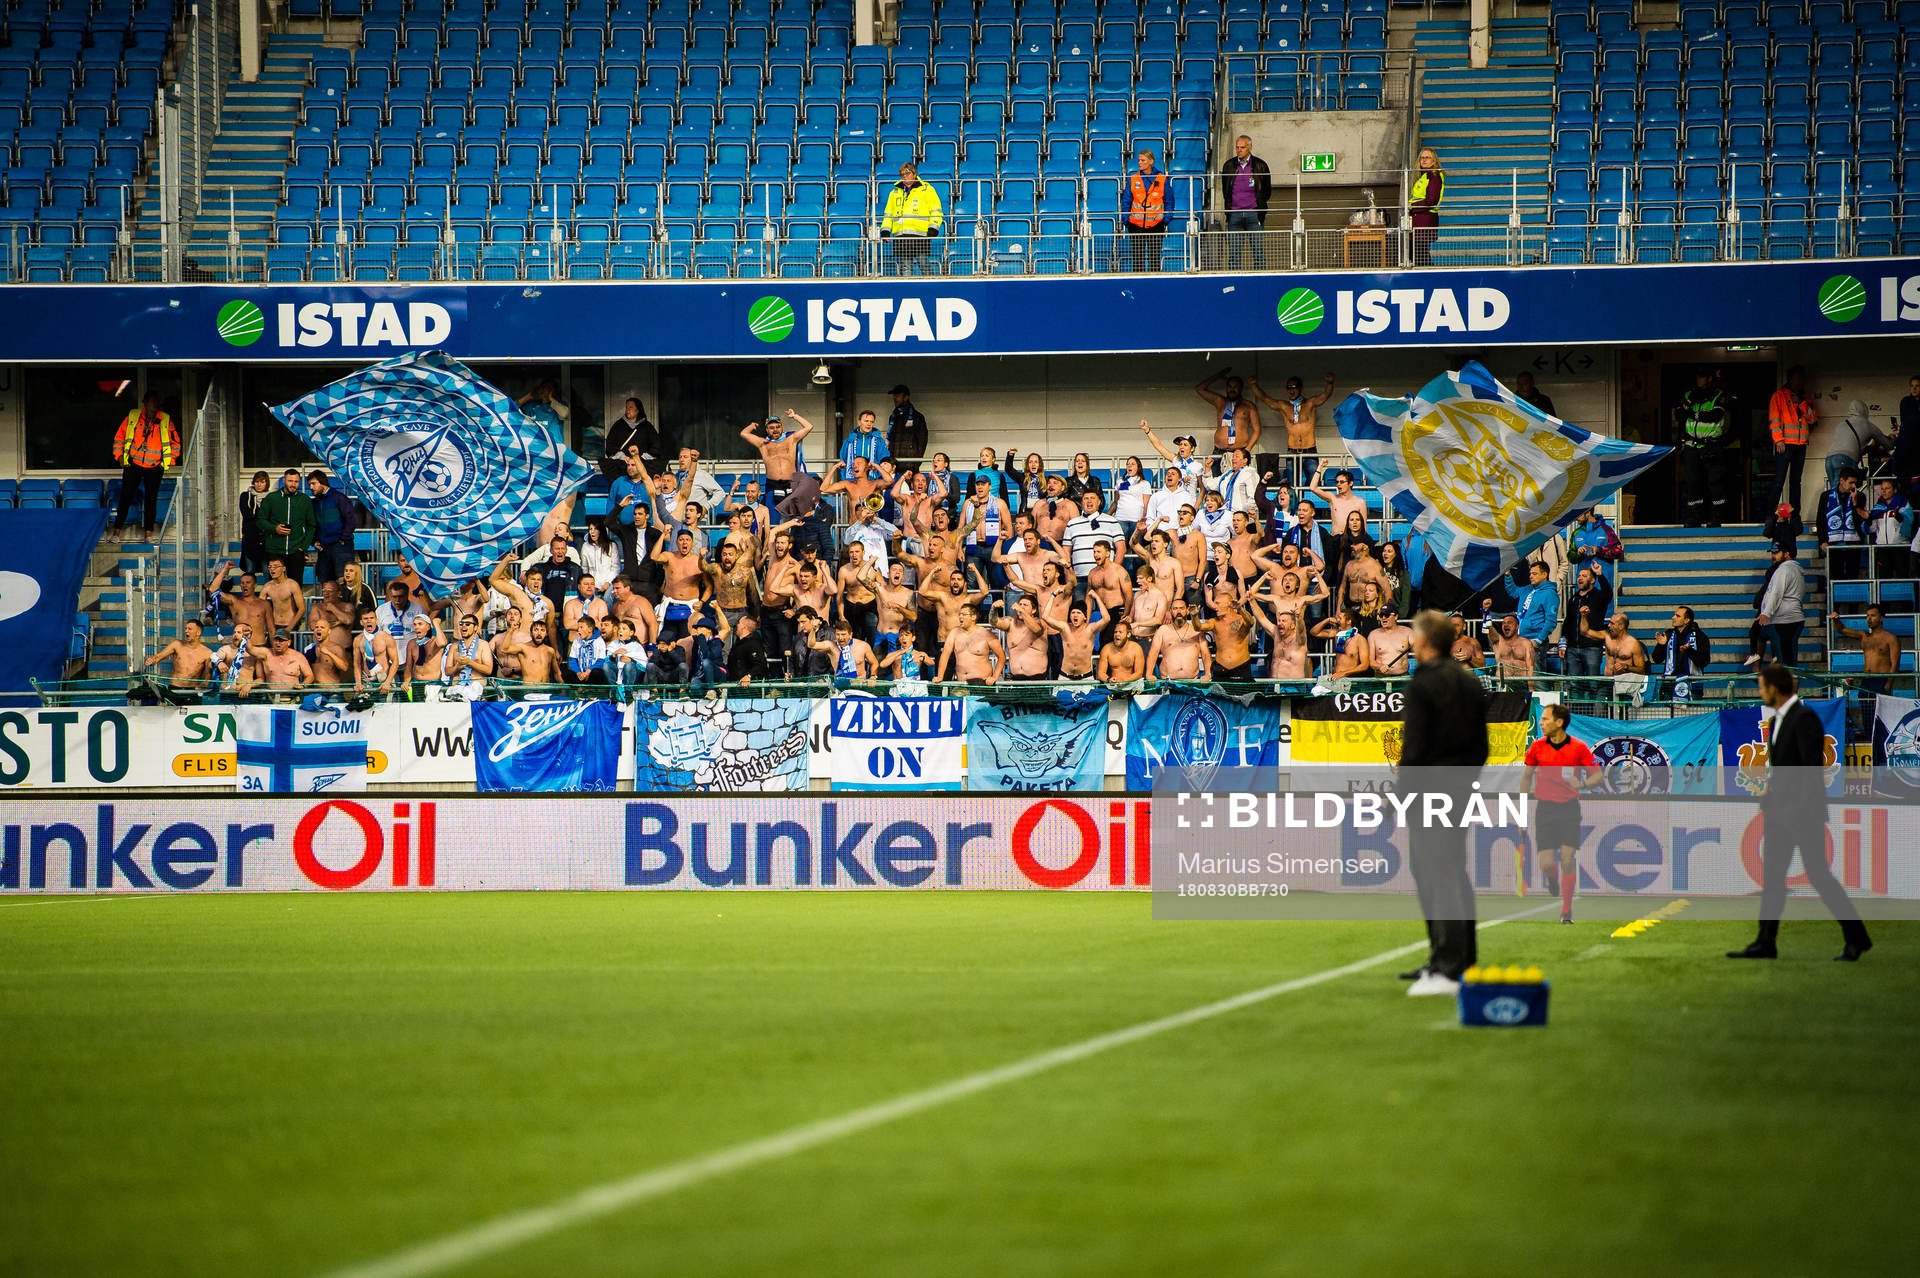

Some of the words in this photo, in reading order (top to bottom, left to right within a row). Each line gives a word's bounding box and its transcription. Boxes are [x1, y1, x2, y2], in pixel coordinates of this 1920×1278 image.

[279, 302, 451, 348] ISTAD
[808, 297, 977, 343] ISTAD
[1337, 287, 1510, 334] ISTAD
[1555, 351, 1576, 375] K
[402, 422, 431, 432] КЛУБ
[302, 719, 361, 736] SUOMI
[837, 700, 960, 733] ZENIT
[0, 709, 130, 786] STO
[183, 758, 228, 772] FLIS
[868, 746, 925, 779] ON
[293, 799, 436, 891] Oil
[624, 802, 992, 888] Bunker
[1012, 798, 1151, 889] Oil
